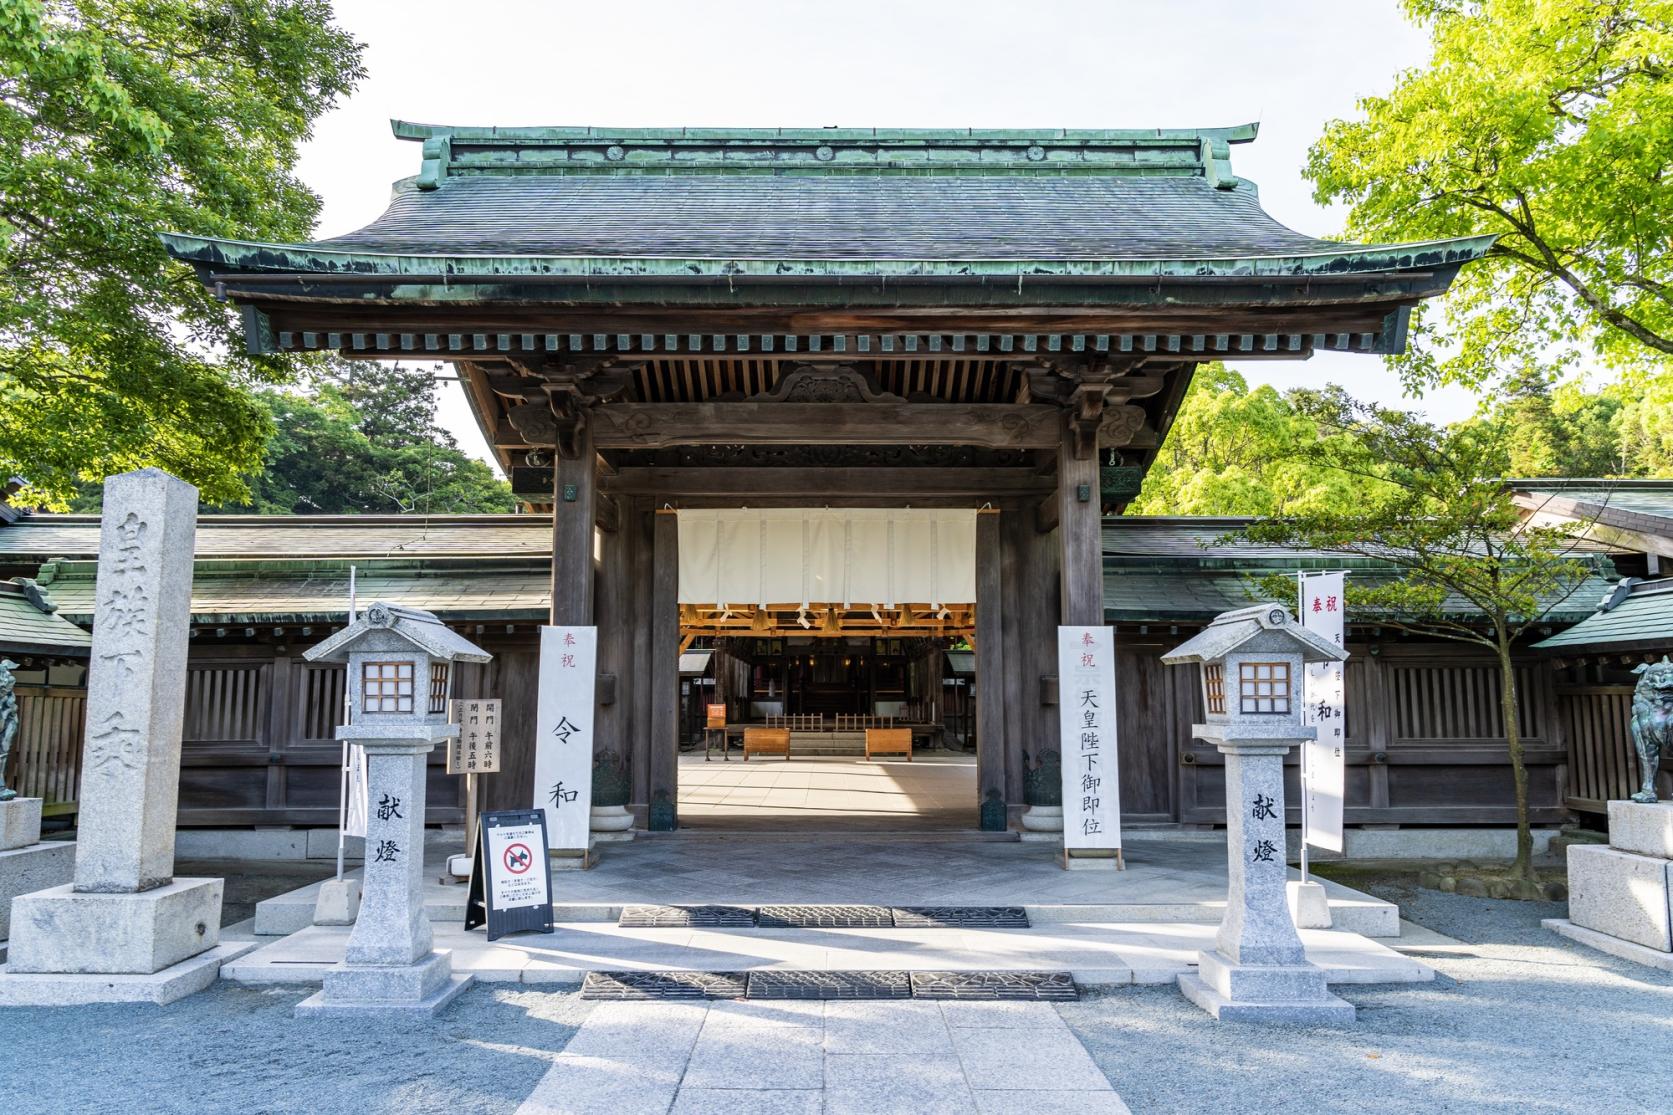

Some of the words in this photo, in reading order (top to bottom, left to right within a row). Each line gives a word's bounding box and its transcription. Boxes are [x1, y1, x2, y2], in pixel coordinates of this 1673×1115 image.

[1312, 595, 1338, 614] 奉祝
[560, 632, 576, 668] 奉祝
[1080, 631, 1096, 667] 奉祝
[549, 716, 582, 809] 令和
[1080, 689, 1102, 836] 天皇陛下御即位
[375, 793, 403, 862] 献燈
[1252, 793, 1278, 863] 献燈
